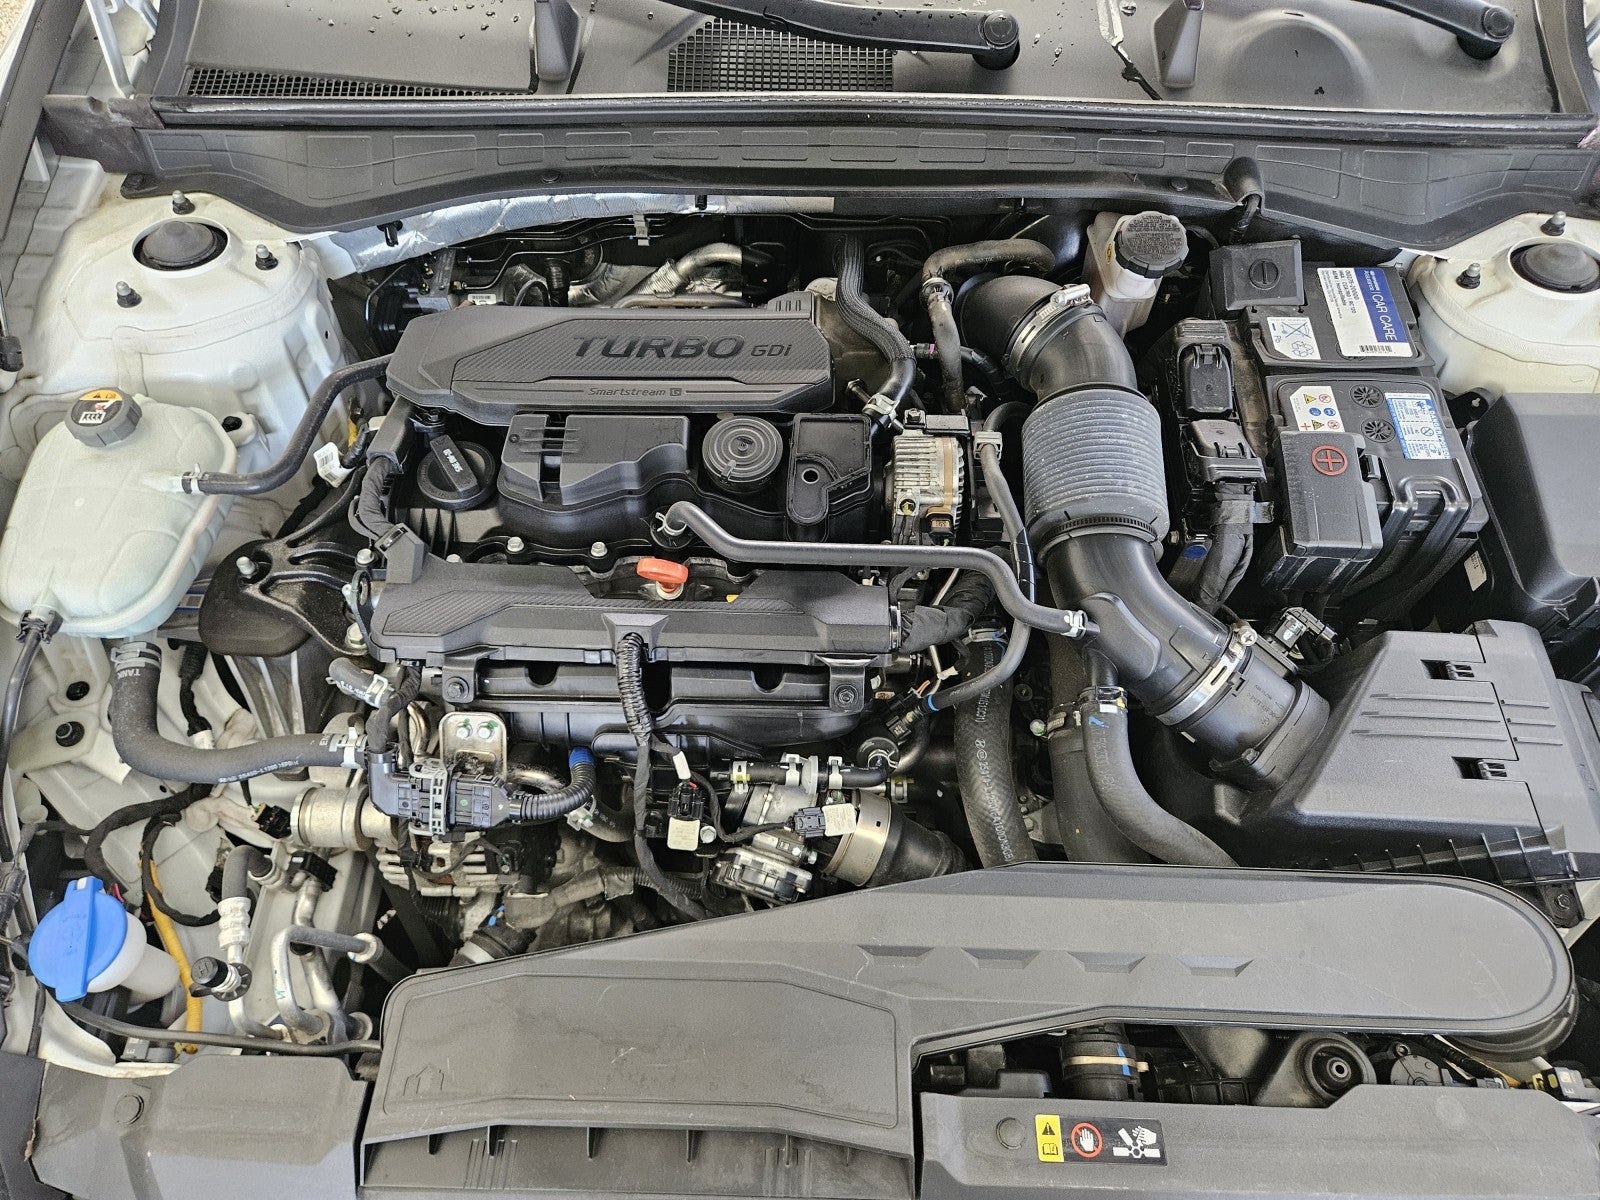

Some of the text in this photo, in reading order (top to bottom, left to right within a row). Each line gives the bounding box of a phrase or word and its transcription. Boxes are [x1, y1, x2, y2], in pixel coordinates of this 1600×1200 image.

[1372, 294, 1388, 313] CAR
[1380, 315, 1398, 341] CARE
[573, 334, 745, 358] TURBO
[588, 387, 666, 397] Smartstream
[117, 668, 141, 680] TANK
